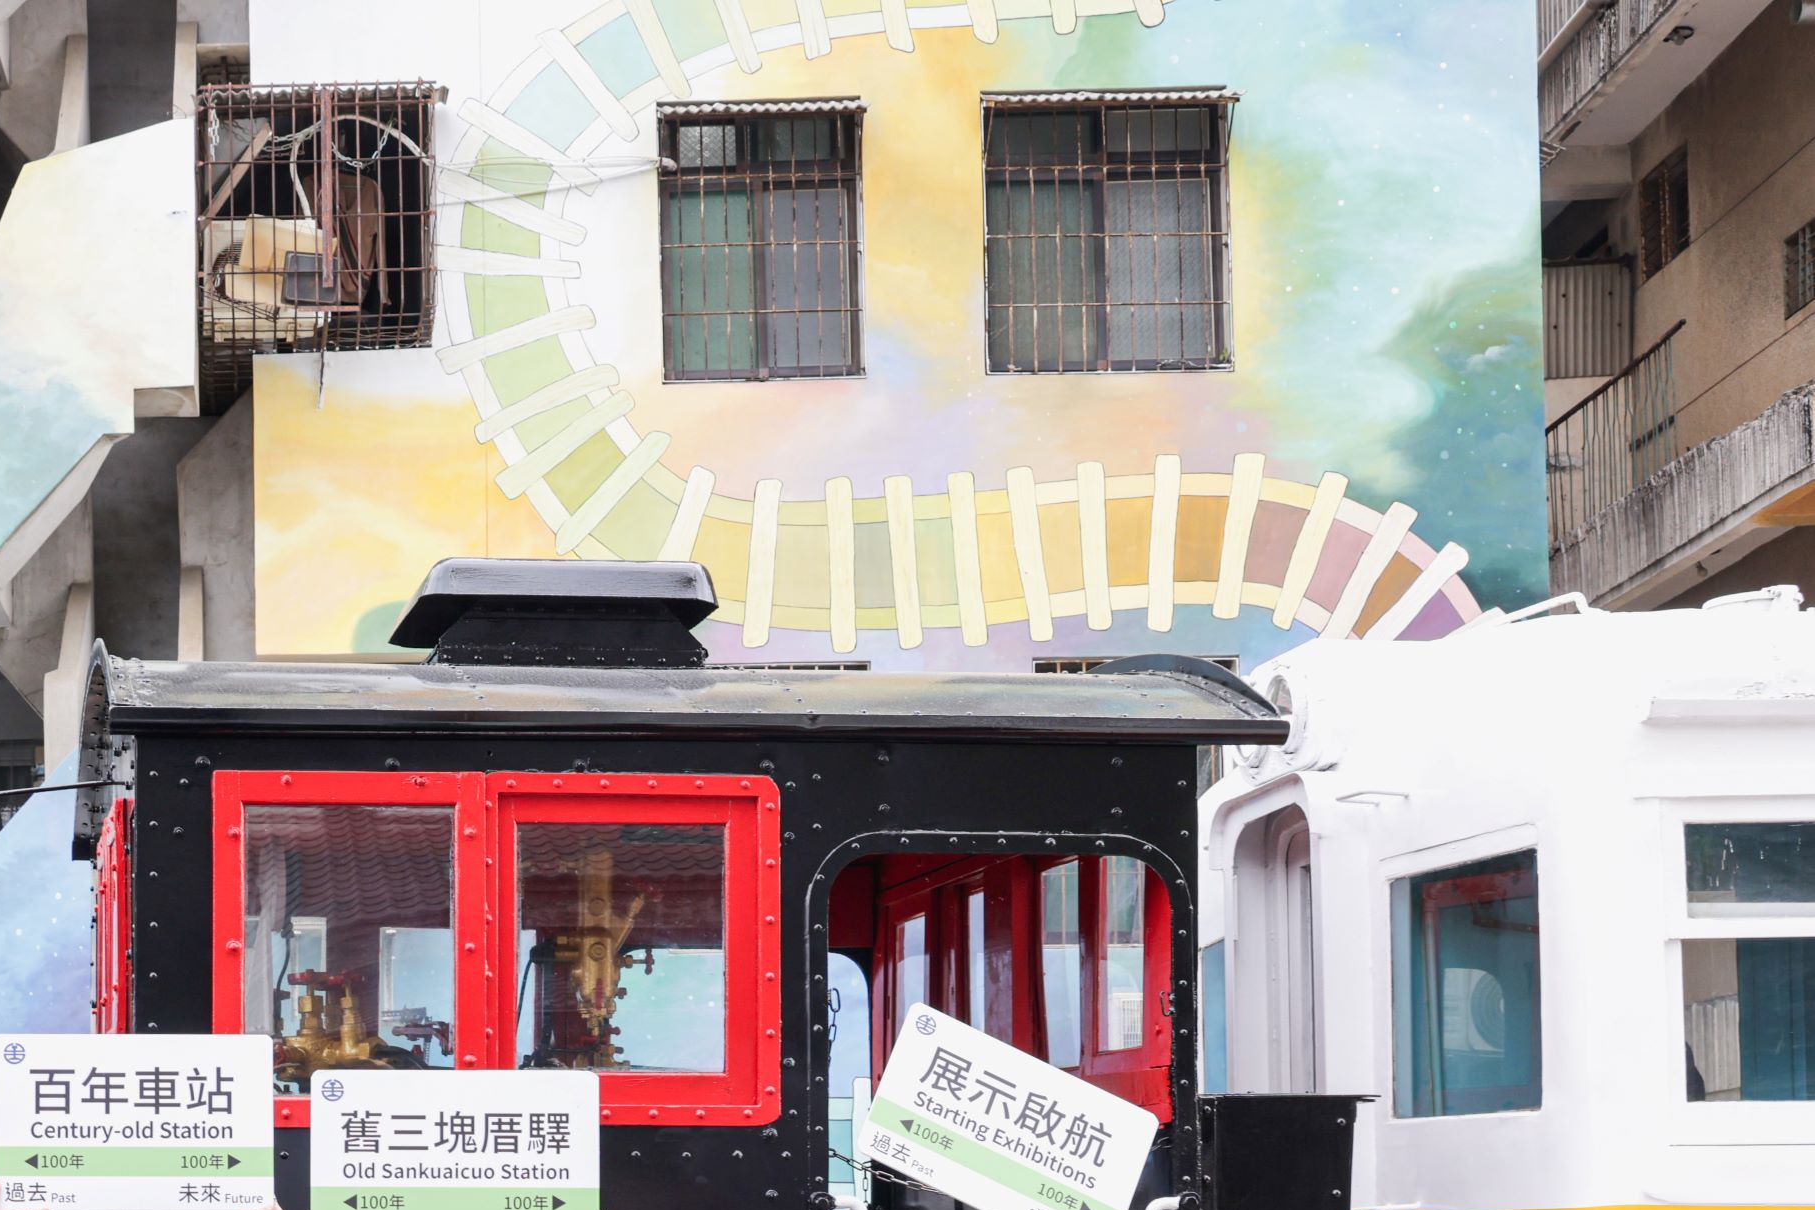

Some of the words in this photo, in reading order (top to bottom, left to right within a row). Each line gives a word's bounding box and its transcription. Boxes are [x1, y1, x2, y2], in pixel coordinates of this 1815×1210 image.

[30, 1067, 233, 1114] 百年車站
[920, 1047, 1112, 1167] 展示啟航
[31, 1121, 153, 1143] Century-old
[161, 1121, 232, 1139] Station
[341, 1111, 570, 1154] 舊三塊厝驛
[913, 1124, 953, 1150] 100年
[914, 1092, 991, 1142] Starting
[993, 1129, 1096, 1188] Exhibitions
[42, 1154, 84, 1168] 100年
[181, 1155, 224, 1169] 100年
[870, 1132, 910, 1163] 過去
[910, 1159, 935, 1178] Past
[343, 1163, 374, 1178] Old
[382, 1163, 494, 1179] Sankuaicuo
[502, 1163, 569, 1179] Station
[5, 1183, 46, 1202] 過去
[51, 1192, 76, 1204] Past
[179, 1183, 220, 1203] 未來
[224, 1193, 264, 1204] Future
[361, 1195, 405, 1210] 100年
[505, 1196, 548, 1210] 100年
[1037, 1184, 1083, 1209] 100年
